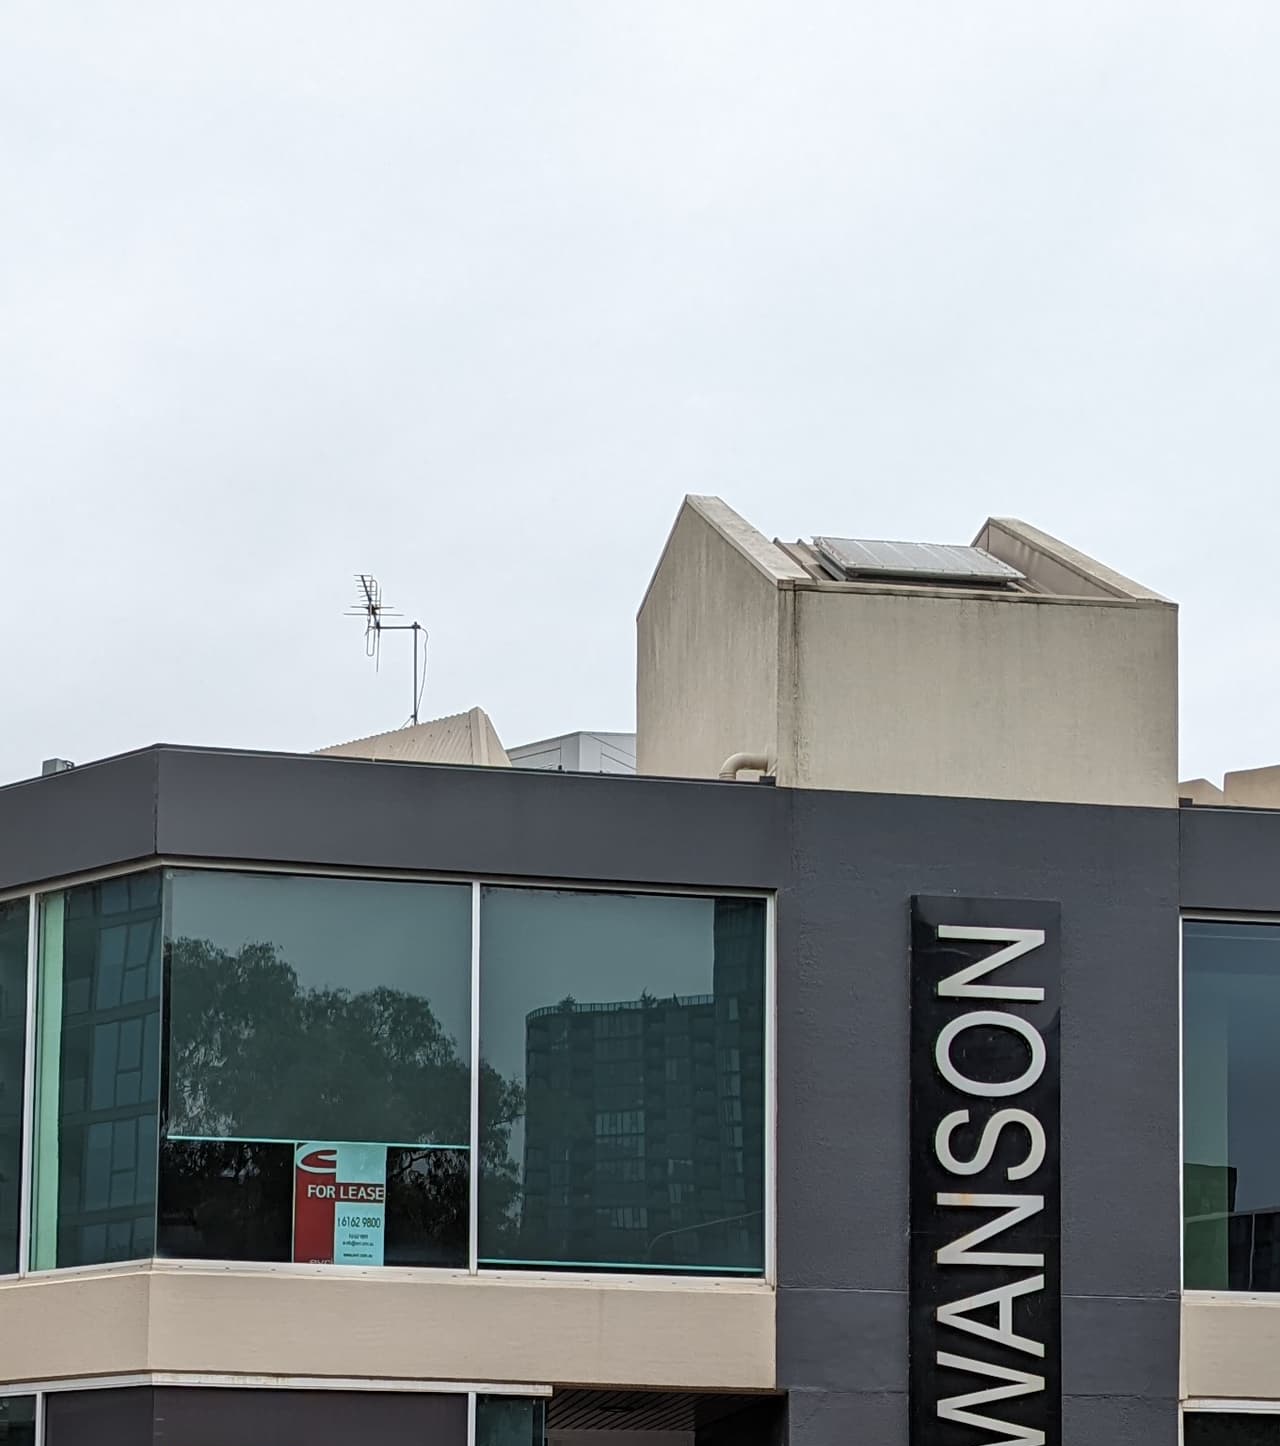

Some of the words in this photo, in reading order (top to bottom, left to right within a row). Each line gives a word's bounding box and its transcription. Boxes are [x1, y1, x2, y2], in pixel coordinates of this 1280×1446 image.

[307, 1184, 335, 1199] FOR
[340, 1185, 385, 1201] LEASE
[341, 1216, 360, 1228] 6162
